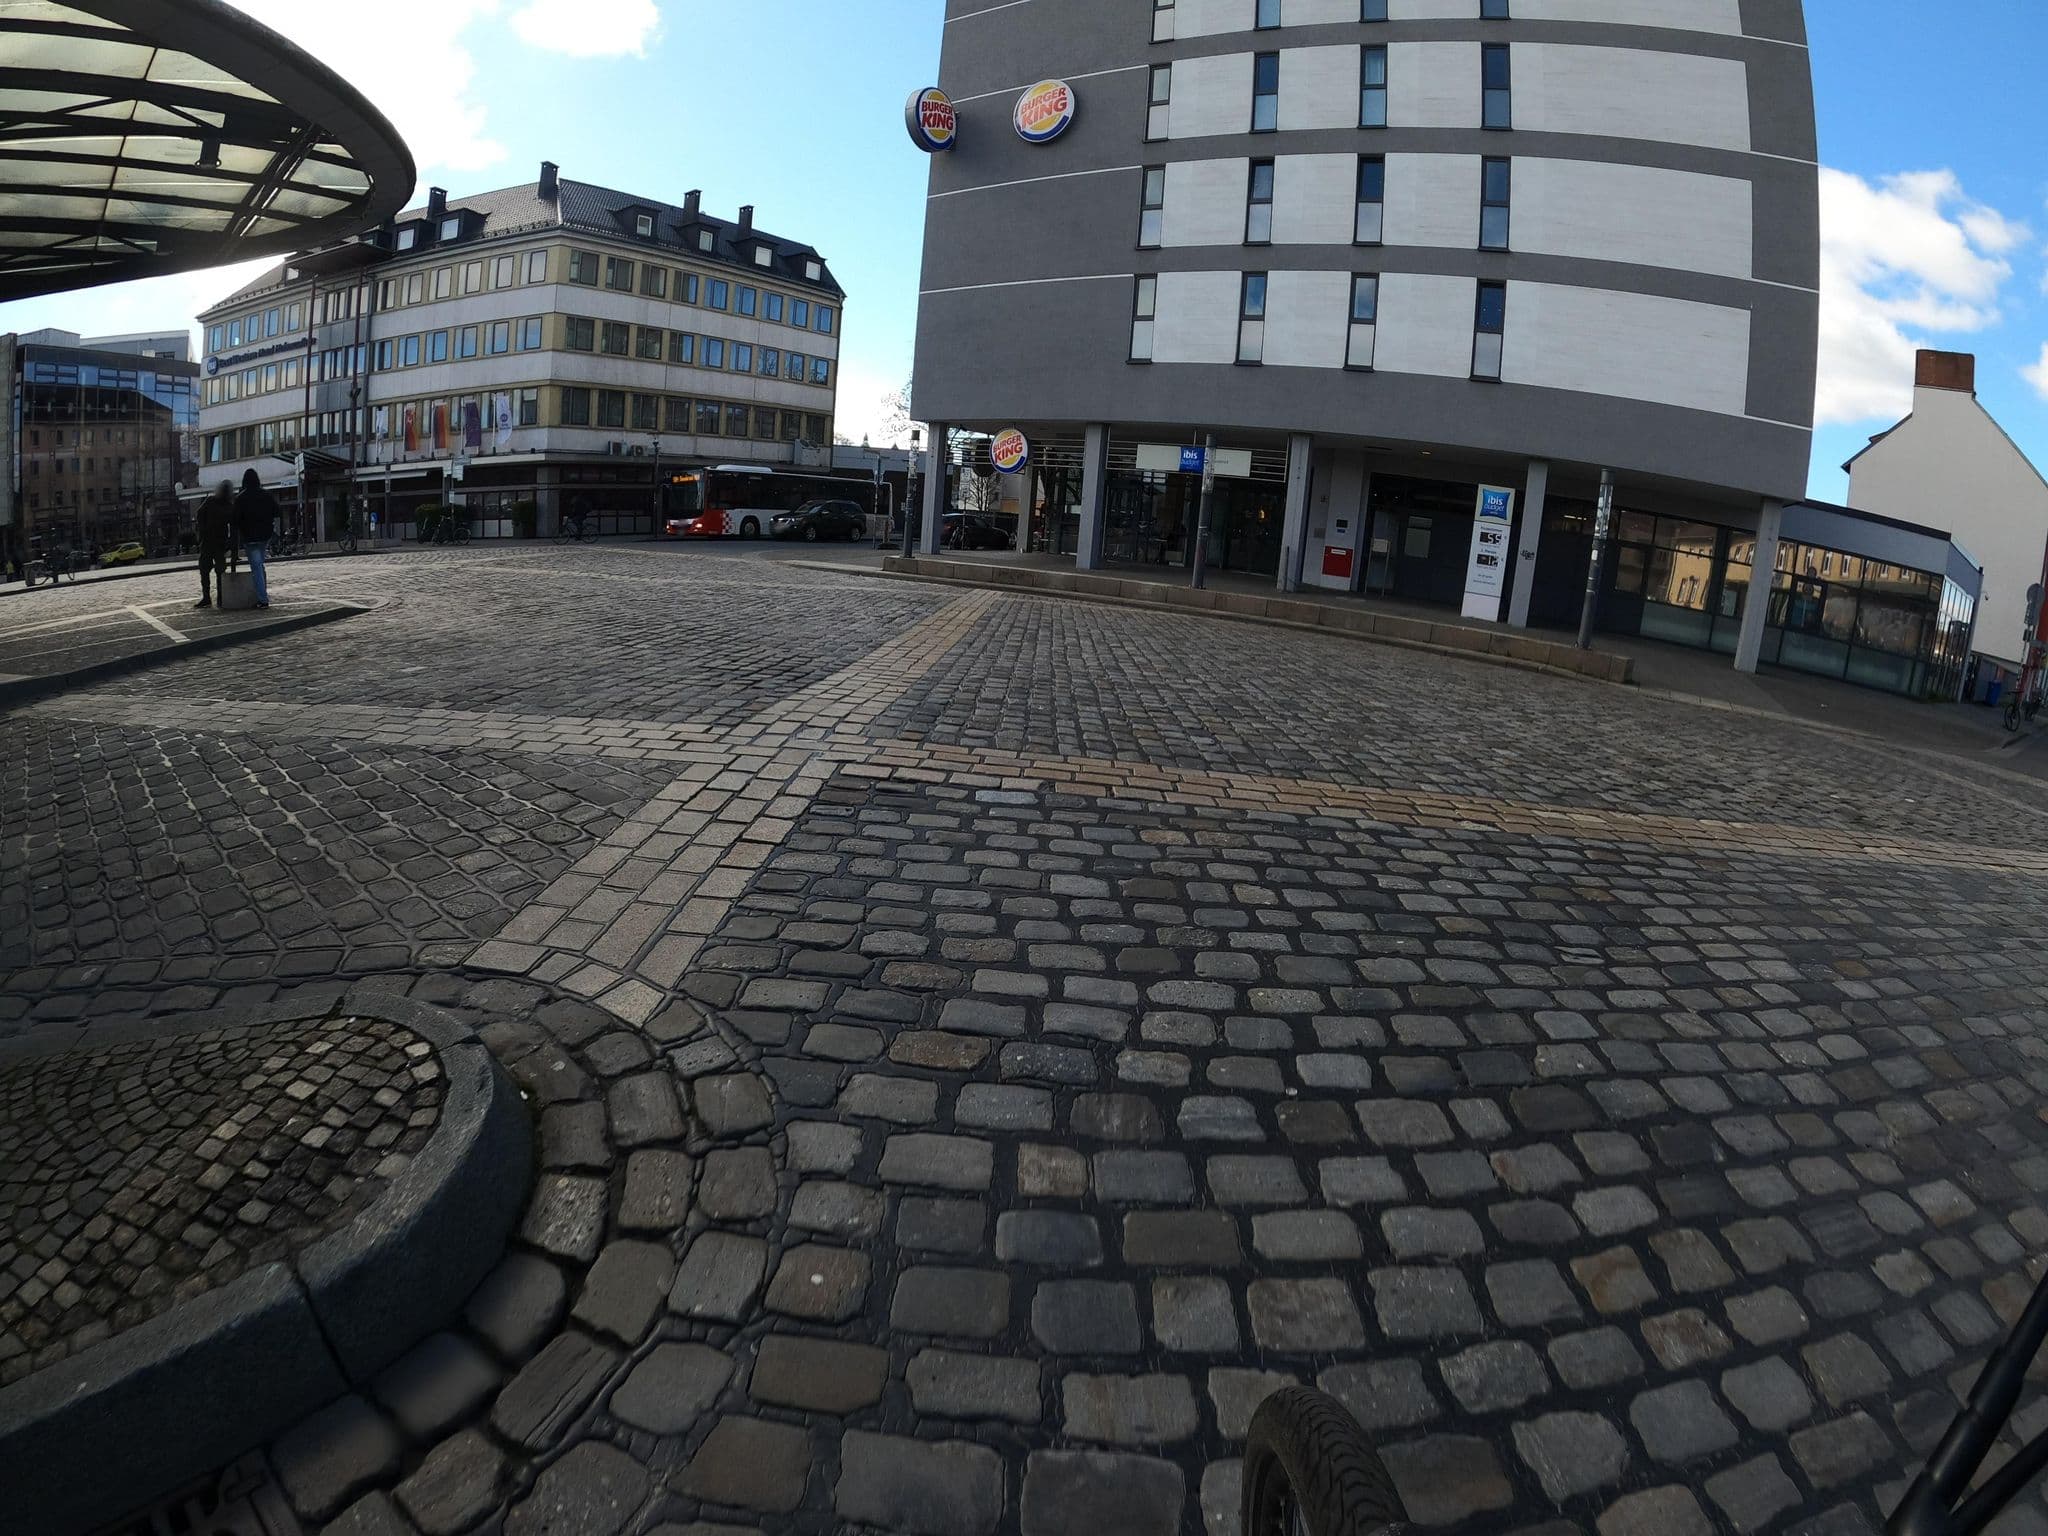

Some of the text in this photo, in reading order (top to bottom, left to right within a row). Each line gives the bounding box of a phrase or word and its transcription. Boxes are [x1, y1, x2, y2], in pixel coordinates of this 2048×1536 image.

[921, 101, 953, 114] BURGER
[1021, 87, 1066, 114] BURGER
[921, 113, 954, 129] KING
[1021, 97, 1067, 129] KING
[993, 435, 1021, 453] BURGER
[995, 442, 1023, 462] KING
[1183, 449, 1198, 459] ibis
[1488, 495, 1503, 505] ibis
